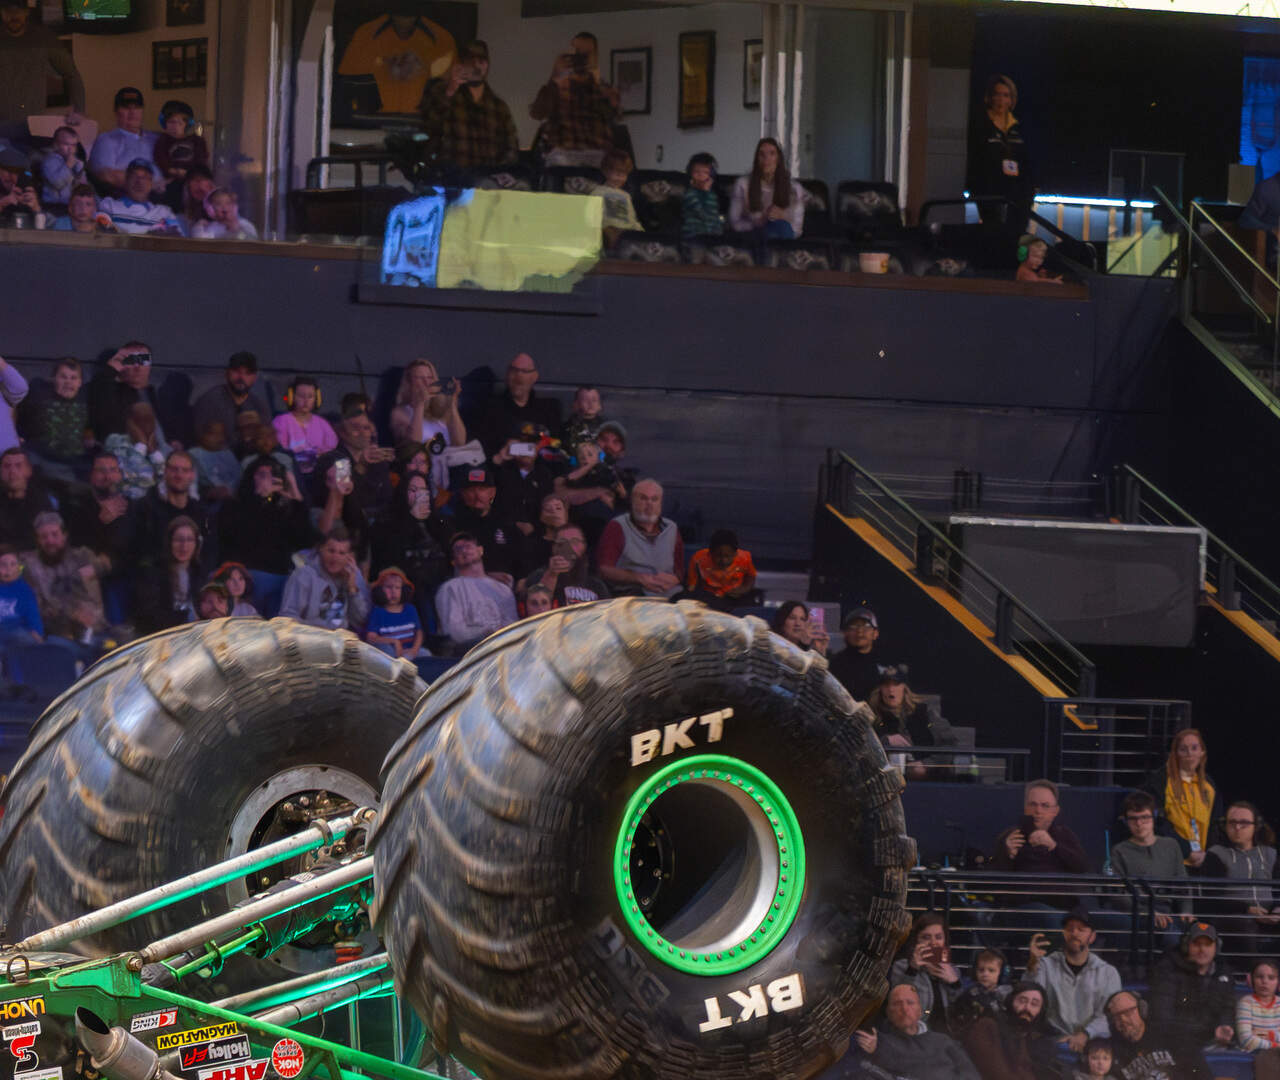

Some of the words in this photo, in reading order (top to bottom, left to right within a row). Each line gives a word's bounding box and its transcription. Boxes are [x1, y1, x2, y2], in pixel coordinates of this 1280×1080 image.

[631, 707, 734, 767] BKT
[699, 973, 803, 1033] BKT
[159, 1023, 236, 1048] MAGNAFLOW
[208, 1041, 249, 1060] Holley
[278, 1059, 300, 1069] NGK
